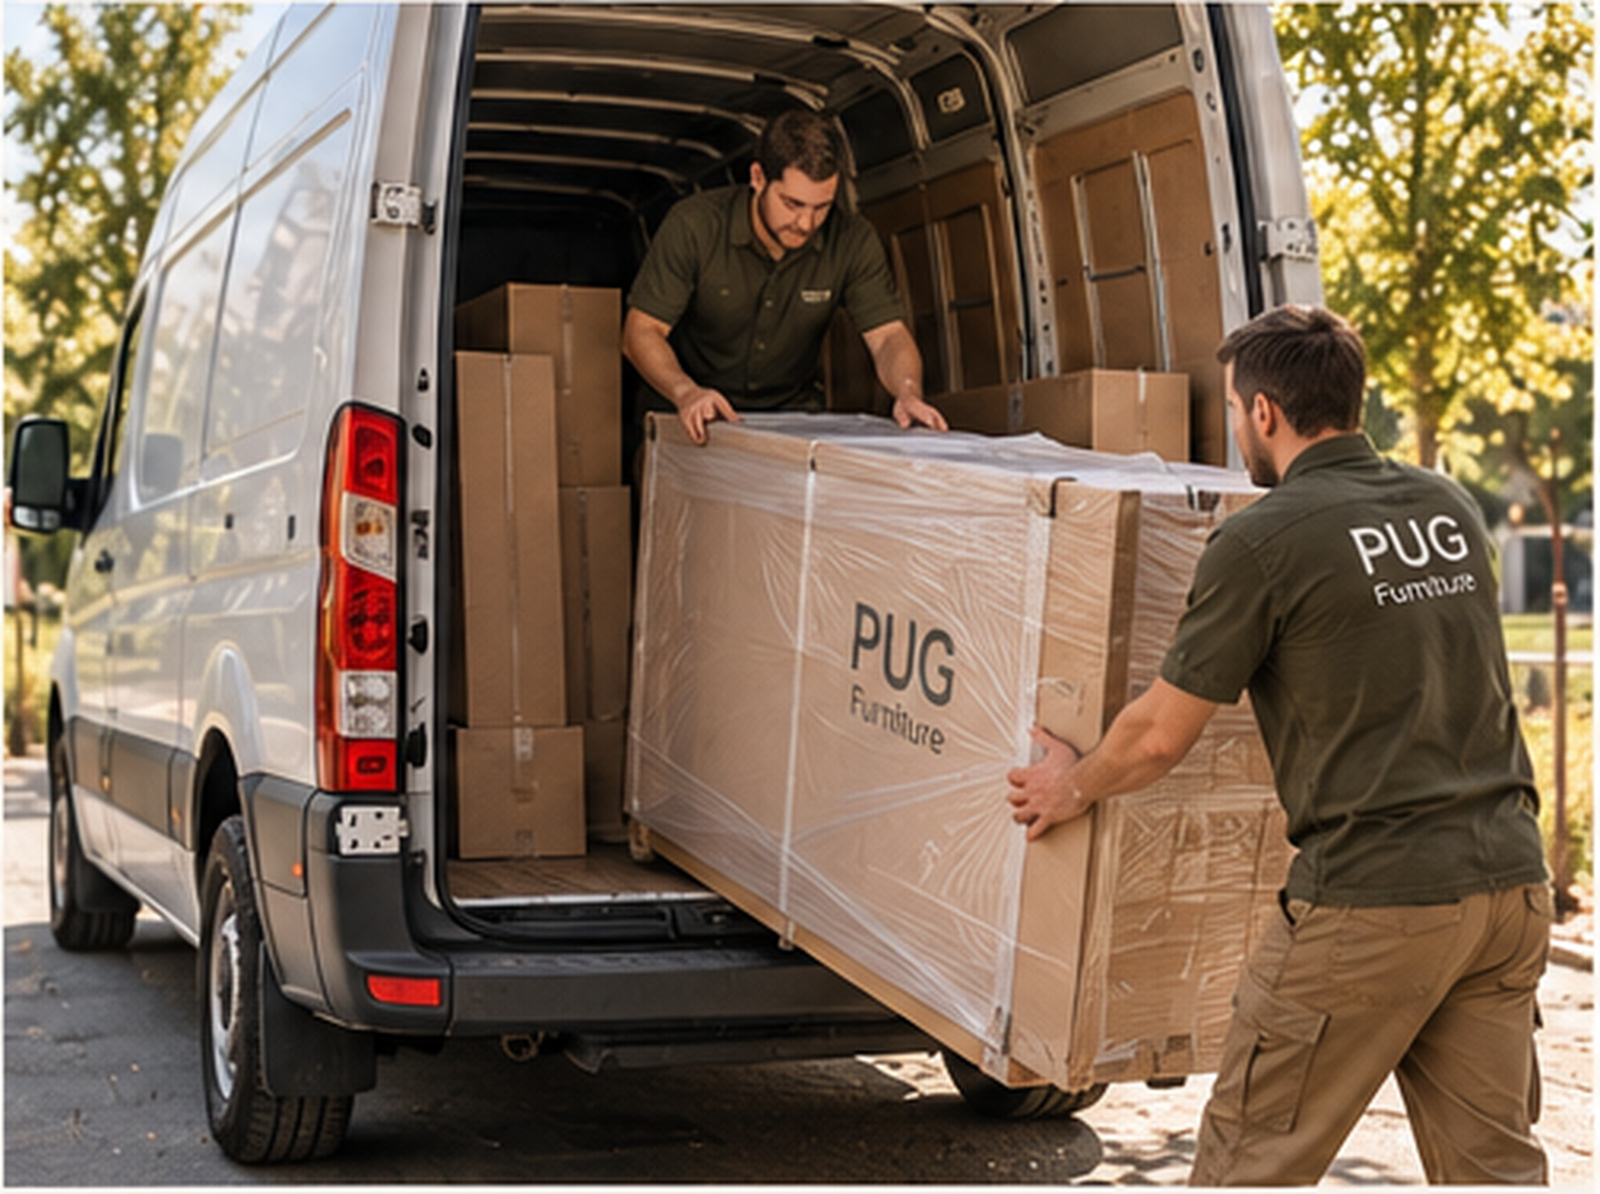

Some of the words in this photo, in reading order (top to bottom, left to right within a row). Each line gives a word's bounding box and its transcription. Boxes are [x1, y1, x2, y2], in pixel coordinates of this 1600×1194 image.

[1349, 514, 1469, 576] PUG
[851, 602, 955, 707] PUG
[850, 683, 946, 755] Furniture
